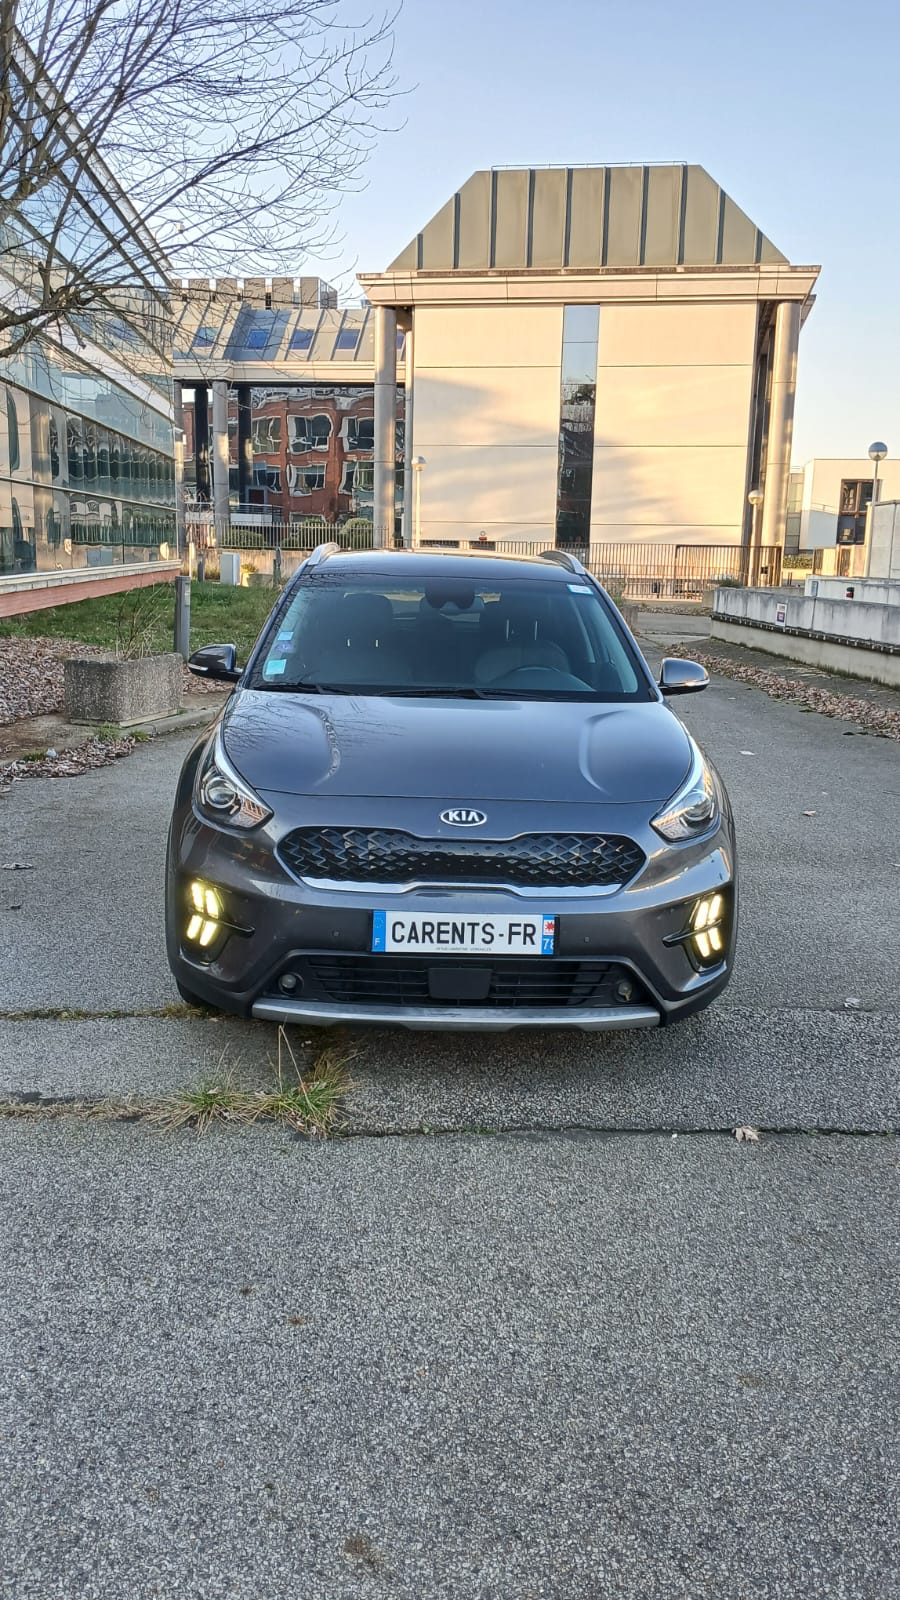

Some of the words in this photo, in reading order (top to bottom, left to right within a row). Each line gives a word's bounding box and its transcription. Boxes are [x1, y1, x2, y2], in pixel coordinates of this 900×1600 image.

[448, 810, 480, 822] KIA
[391, 921, 537, 946] CARENTS-FR
[374, 937, 381, 946] F
